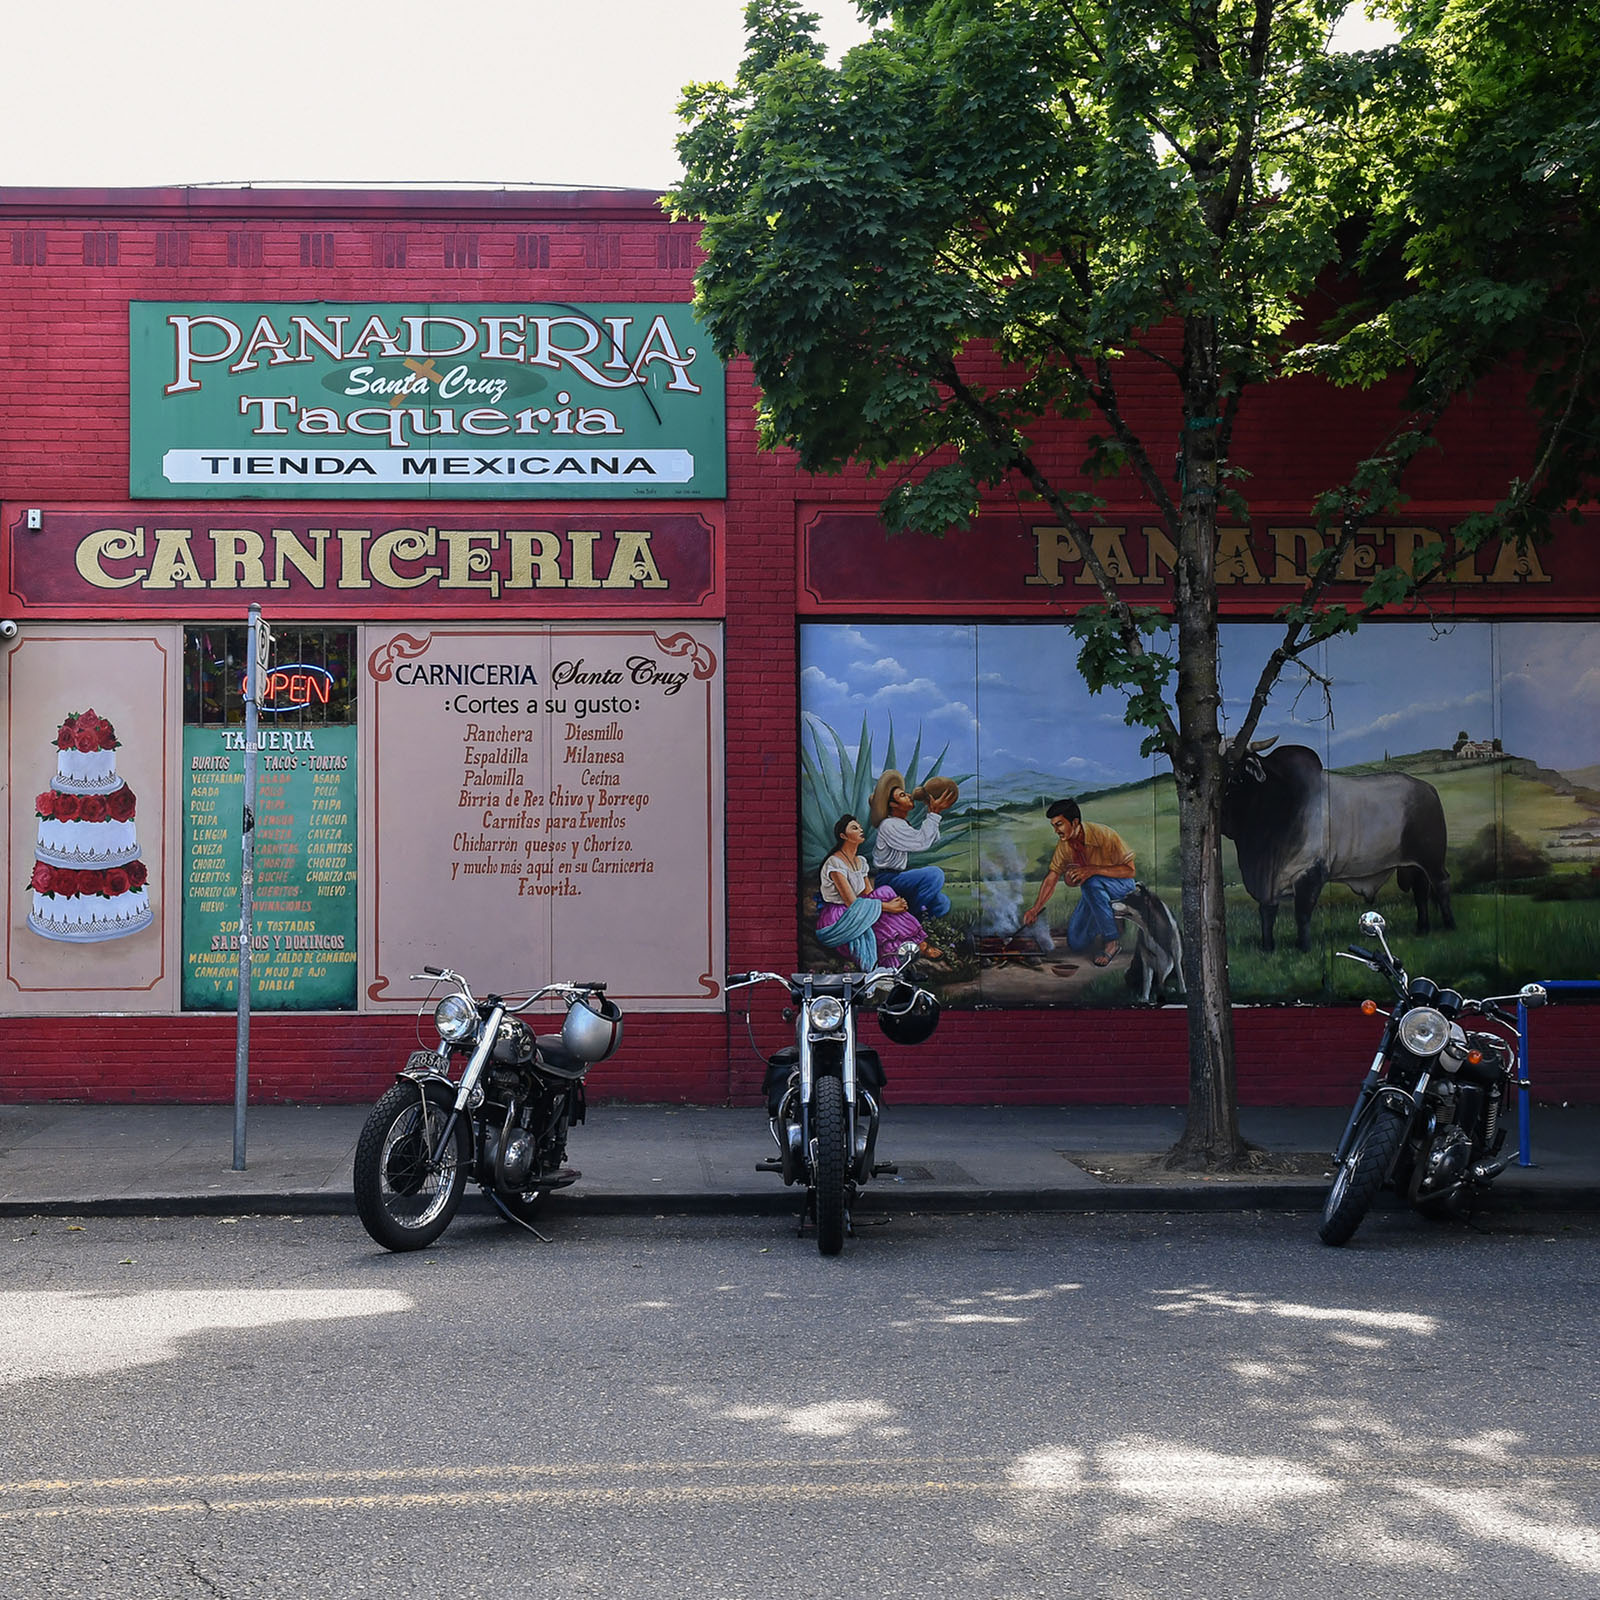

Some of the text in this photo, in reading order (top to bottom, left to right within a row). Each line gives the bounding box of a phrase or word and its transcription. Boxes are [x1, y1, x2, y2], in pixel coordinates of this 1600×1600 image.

[164, 315, 701, 395] PANADERIA
[344, 365, 508, 404] Santa Cruz
[239, 391, 624, 448] Taqueria
[201, 457, 657, 475] TIENDA MEXICANA
[74, 525, 670, 599] CARNICERIA
[1024, 526, 1552, 586] PANADERIA
[395, 656, 690, 696] CARNICERIA Santa Cruz
[526, 700, 538, 713] a
[545, 700, 567, 713] su
[463, 724, 534, 743] Ranchera
[564, 722, 624, 741] Diesmillo
[221, 731, 315, 754] TAUERIA
[464, 746, 529, 768] Espaldilla
[563, 746, 625, 764] Milanesa
[191, 756, 230, 771] BURITOS
[264, 756, 298, 771] TACOS
[309, 756, 348, 771] TORTAS
[259, 774, 291, 784] ASADA
[313, 774, 341, 784] ASADA
[462, 768, 524, 787] Palomilla
[581, 768, 620, 786] Cecina
[191, 787, 219, 797] ASADA
[314, 786, 338, 796] POLLO
[259, 800, 285, 810] TRIPA
[312, 800, 341, 810] TRIPA
[458, 785, 650, 813] Birria de Rez Chivo y Borrego
[191, 800, 215, 812] POLLO
[191, 815, 218, 826] TRIPA
[309, 815, 347, 825] LENGUA
[483, 810, 626, 833] Carnitas para Eventos
[193, 829, 228, 840] LENGUA
[257, 829, 292, 840] CAVEZA
[307, 829, 342, 839] CAVEZA
[192, 844, 223, 855] CAVEZA
[525, 841, 566, 859] quesos
[571, 841, 579, 859] y
[192, 859, 225, 870] CHORIZO
[257, 858, 295, 868] CHORIZO
[307, 858, 346, 868] CHORIZO
[451, 861, 459, 879] y
[464, 856, 498, 875] mucho
[501, 860, 522, 874] más
[559, 863, 571, 874] en
[575, 863, 588, 873] su
[591, 857, 654, 873] Carniceria
[190, 872, 231, 883] CUERITOS
[306, 871, 356, 882] CHORIZO CON
[189, 886, 237, 897] CHORIZO CON
[257, 921, 262, 931] Y
[267, 920, 315, 931] TOSTADAS
[273, 935, 281, 950] Y
[285, 935, 345, 950] DOMINGOS
[304, 953, 314, 963] DE
[316, 952, 357, 963] CAMARON
[265, 968, 289, 977] MOJO
[292, 967, 303, 977] DE
[308, 968, 326, 977] AJO
[214, 980, 295, 991] Y A DIABLA
